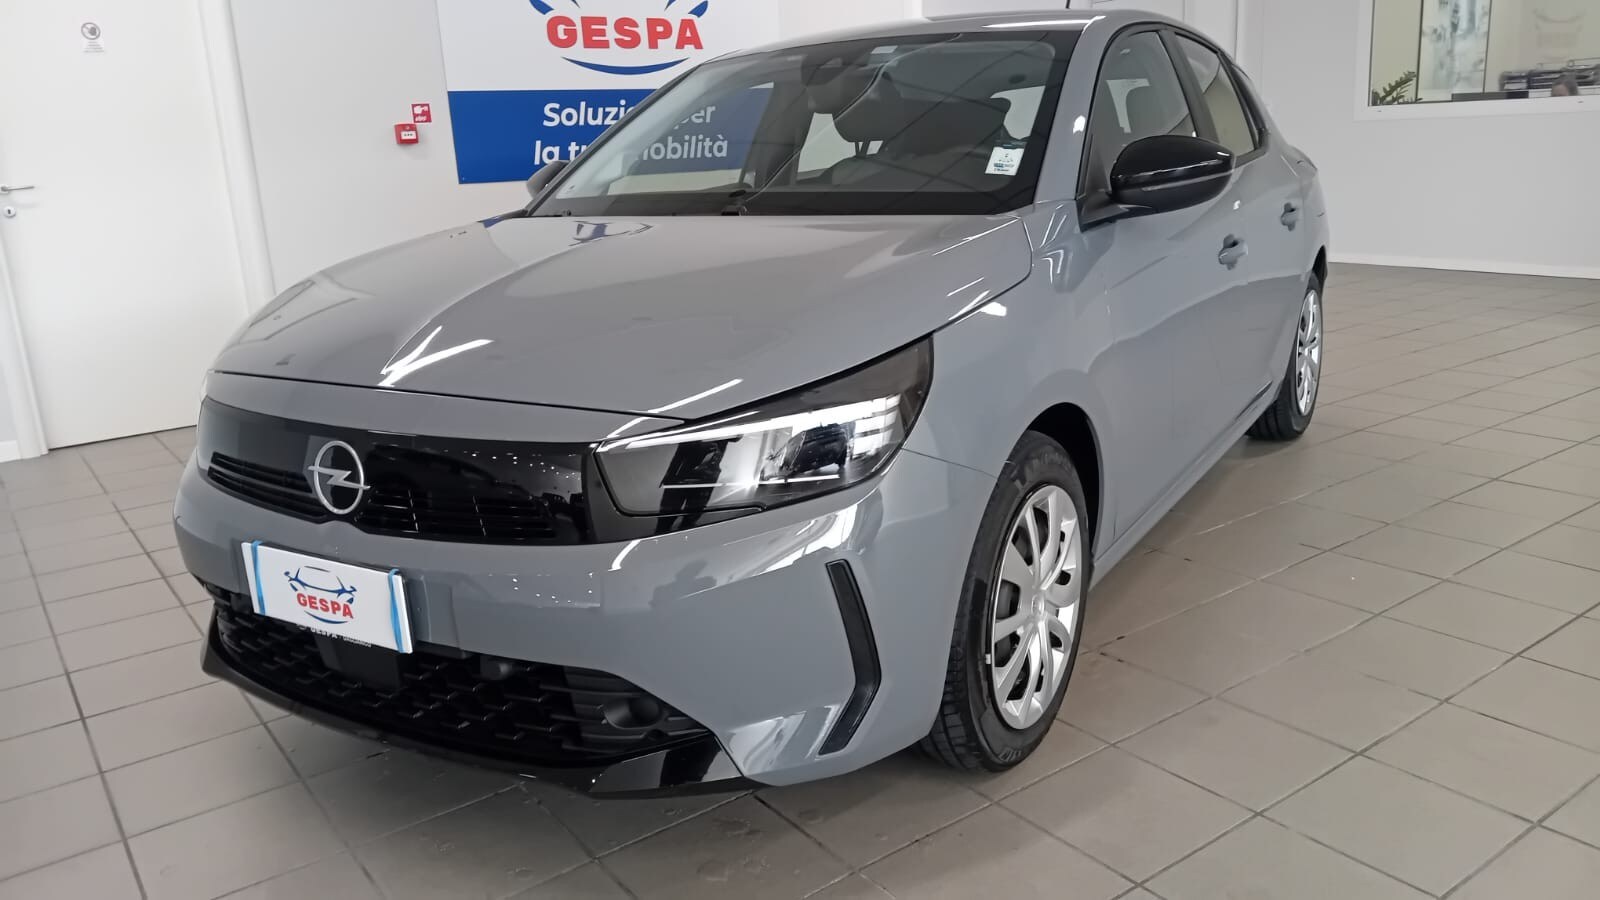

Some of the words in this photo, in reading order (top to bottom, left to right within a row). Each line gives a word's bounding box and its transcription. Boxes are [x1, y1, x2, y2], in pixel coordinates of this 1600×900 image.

[546, 15, 704, 50] GESPA
[533, 140, 560, 165] la
[296, 592, 354, 620] GESPA
